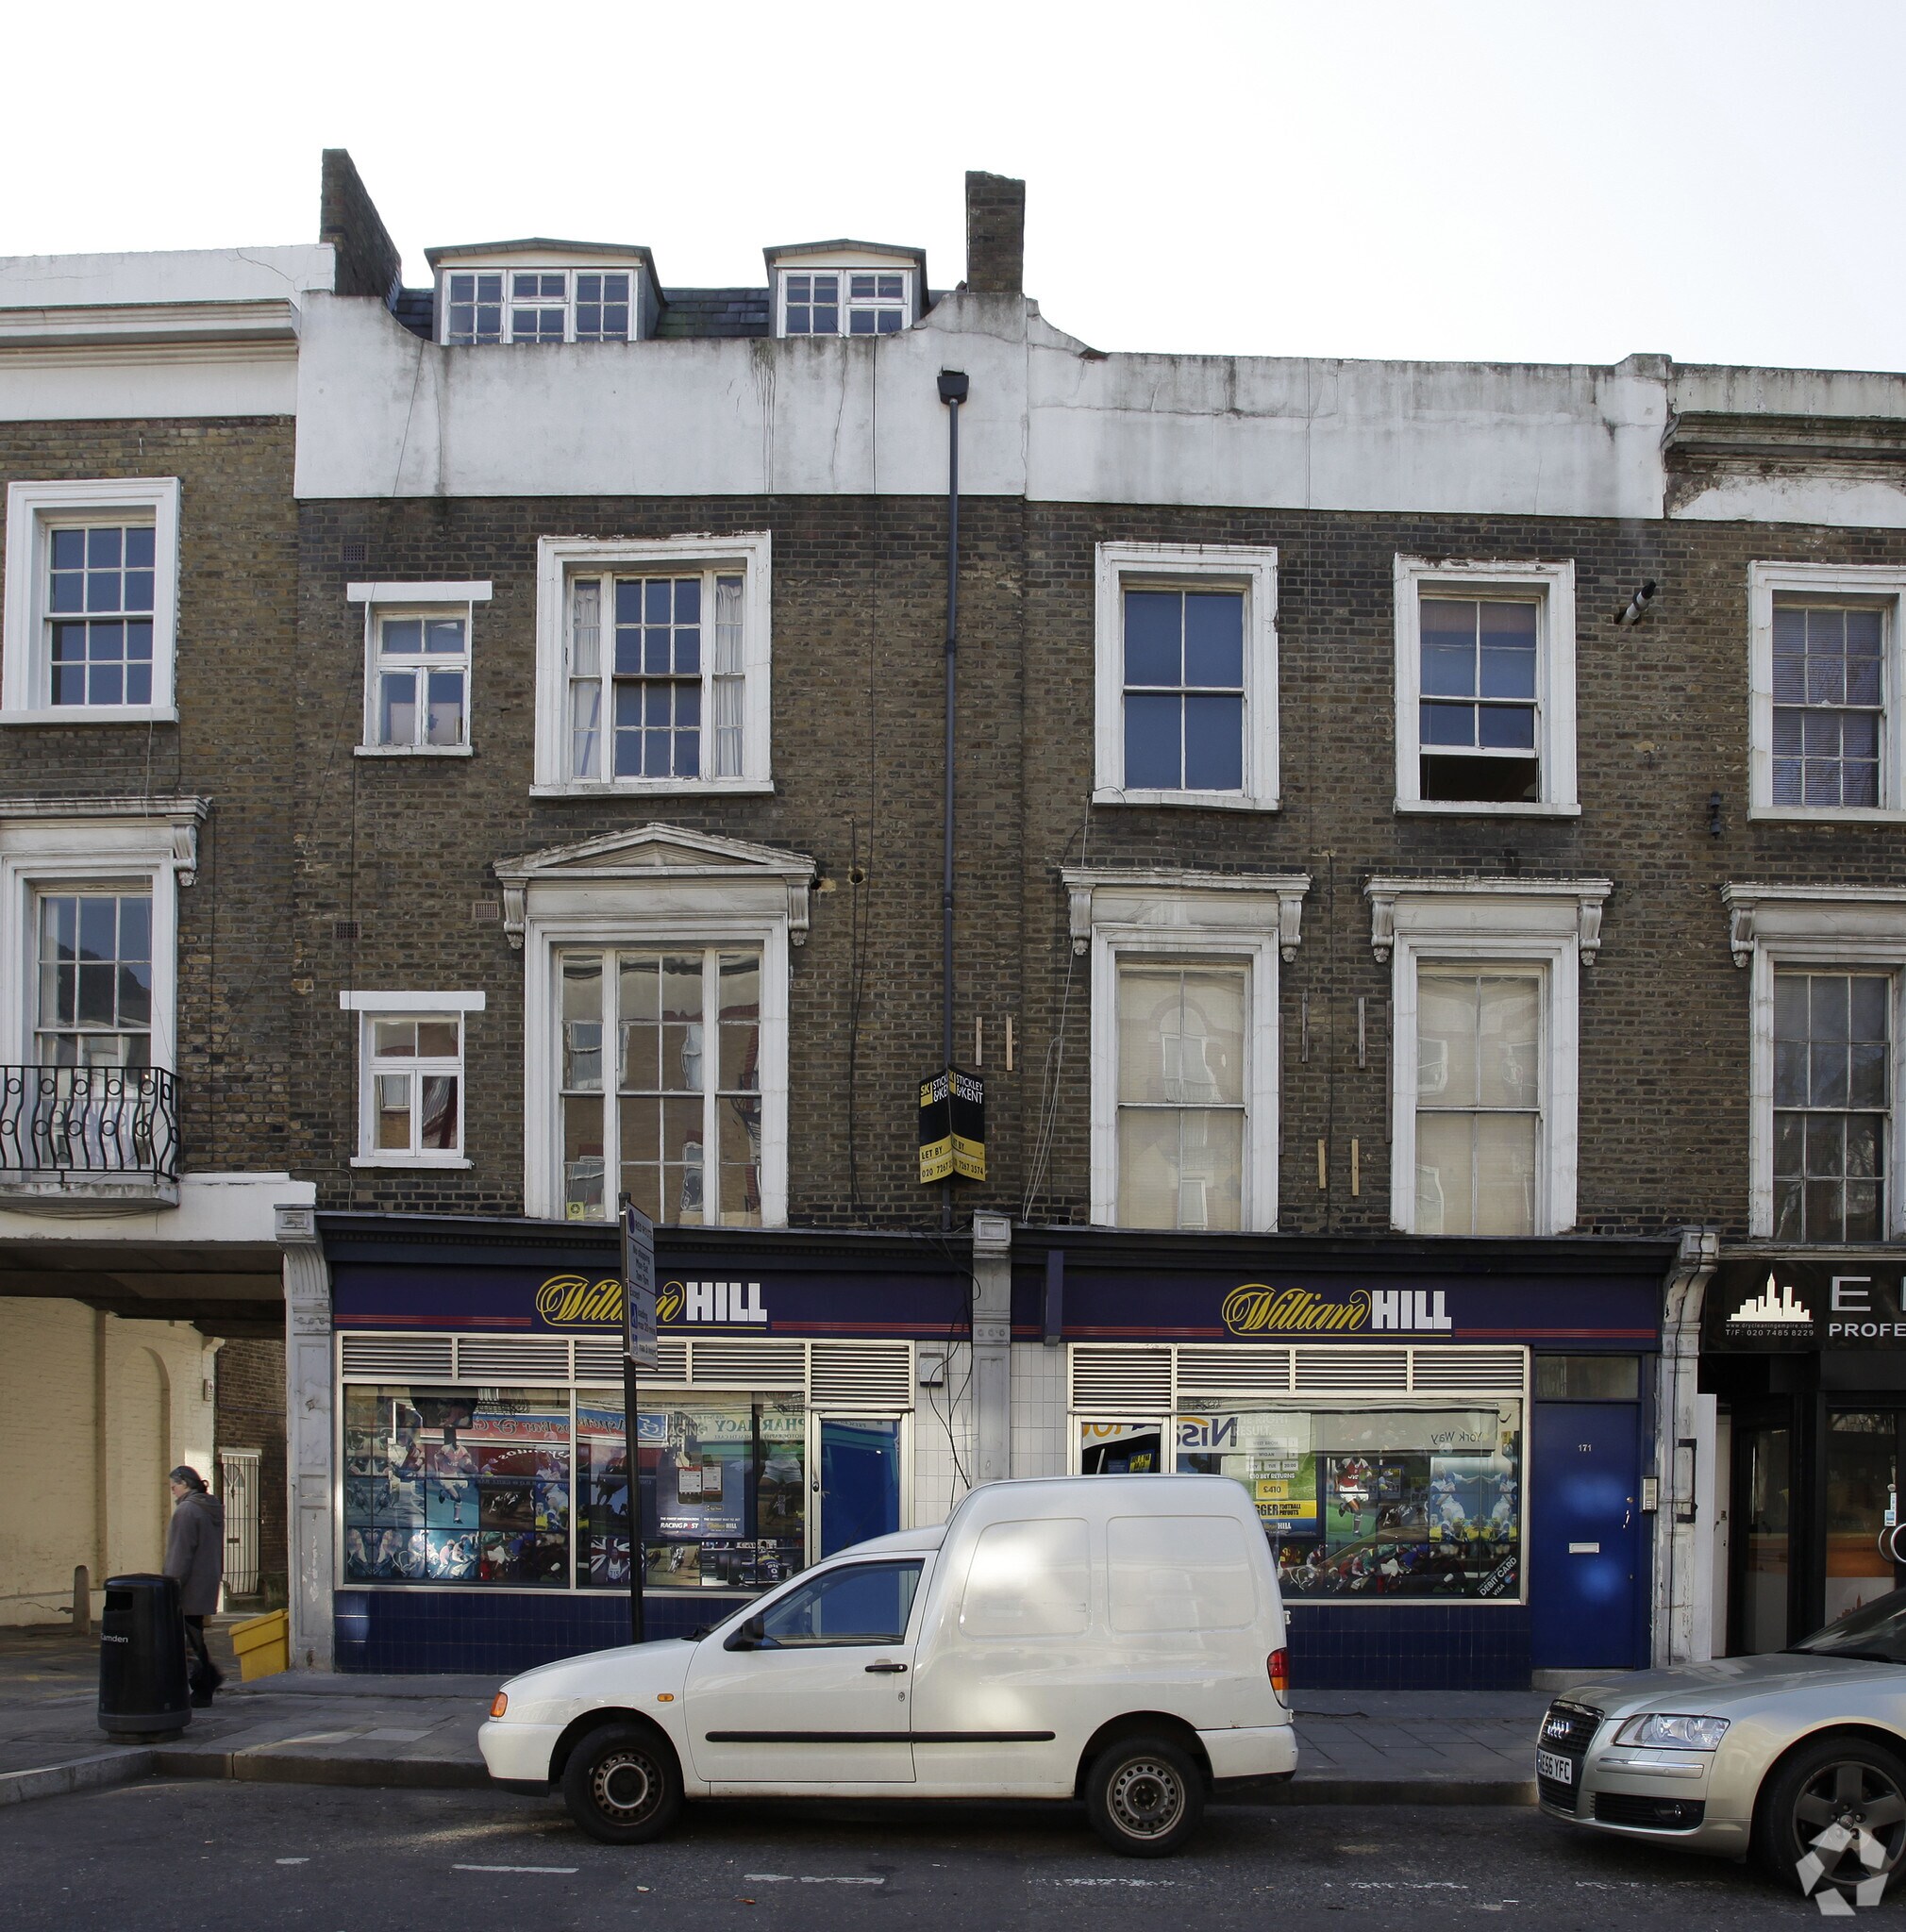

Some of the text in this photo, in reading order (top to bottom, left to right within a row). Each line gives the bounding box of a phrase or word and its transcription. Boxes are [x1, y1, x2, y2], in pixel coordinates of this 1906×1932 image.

[920, 1083, 930, 1096] SK
[956, 1074, 983, 1091] STICKLEY
[921, 1145, 943, 1160] LET BY
[921, 1166, 934, 1178] 020
[971, 1162, 984, 1175] 3574
[686, 1282, 768, 1322] HILL
[1221, 1283, 1452, 1335] William HILL
[1479, 1575, 1498, 1596] DEBIT
[1496, 1557, 1517, 1578] CARD
[1492, 1583, 1506, 1596] VISA
[1554, 1758, 1570, 1781] YFC
